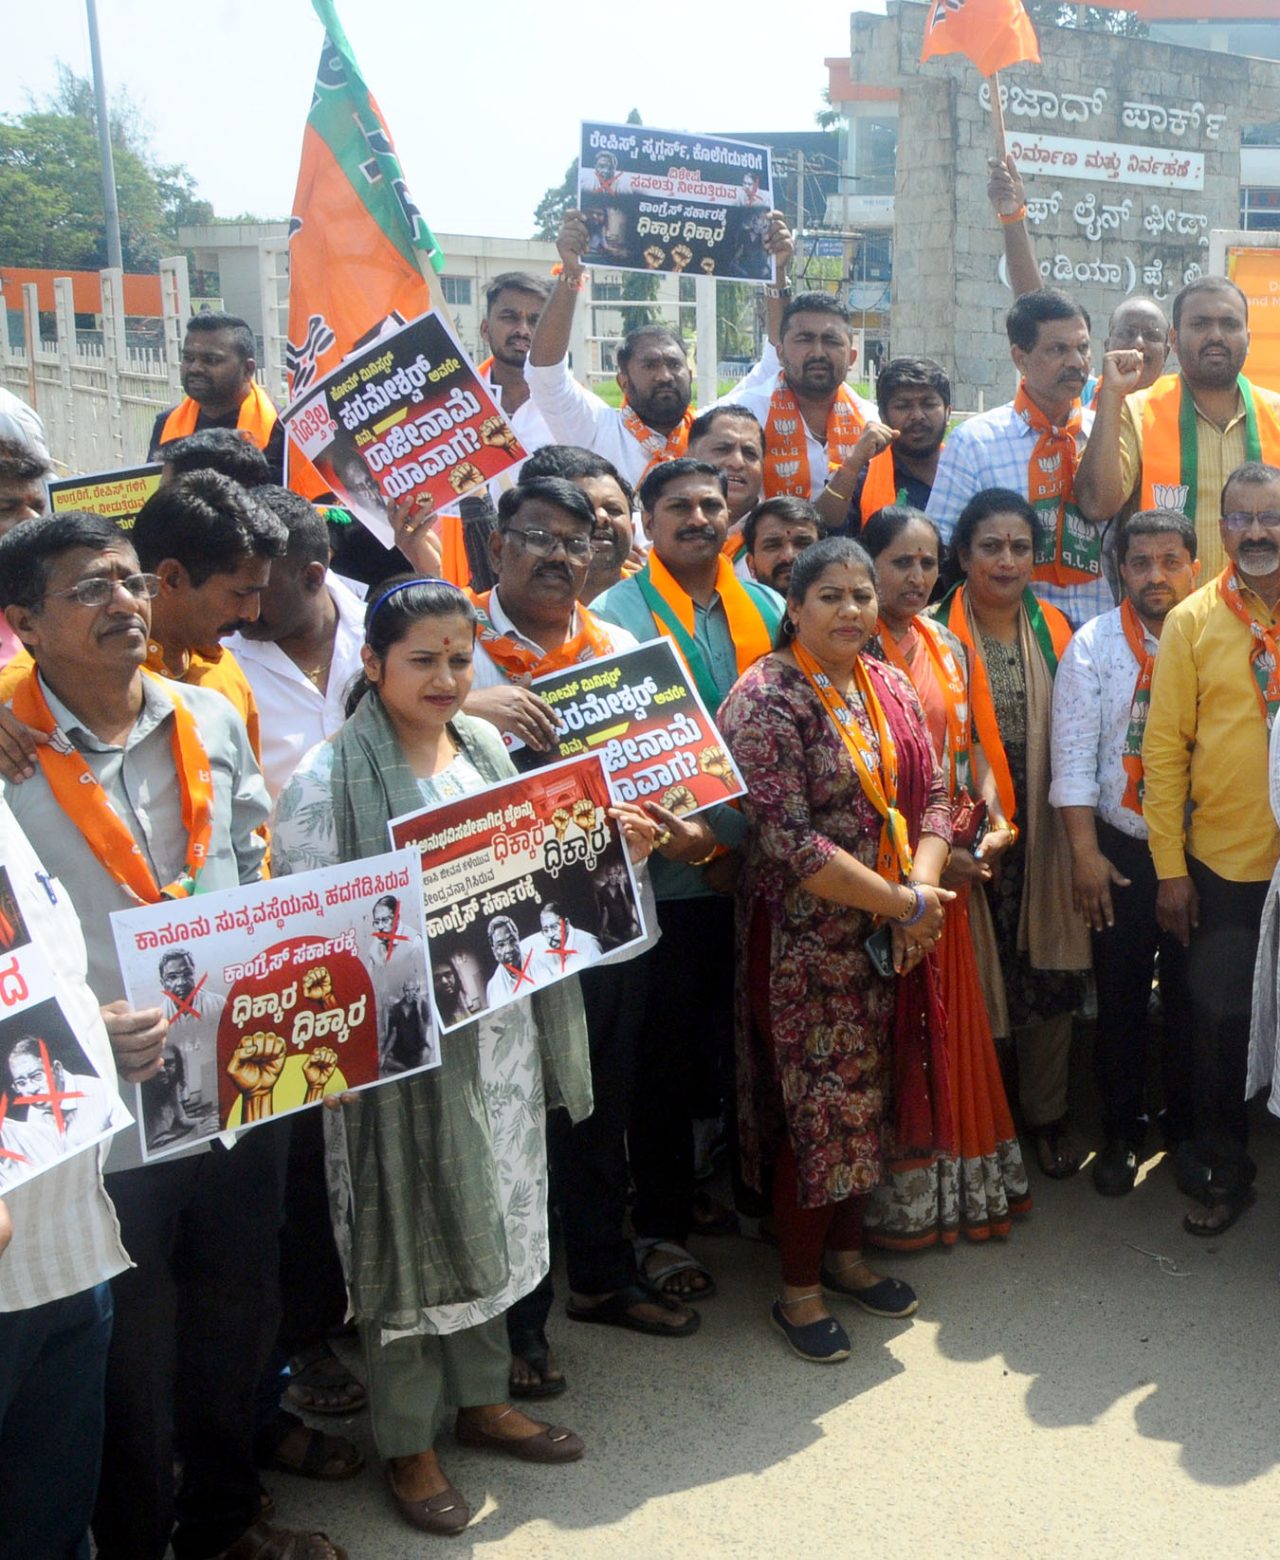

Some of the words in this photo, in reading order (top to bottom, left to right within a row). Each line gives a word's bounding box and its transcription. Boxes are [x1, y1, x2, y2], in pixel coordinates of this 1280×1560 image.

[1122, 102, 1226, 139] ಪಾರ್ಕ್
[1084, 150, 1121, 179] ಮತ್ತು
[638, 200, 683, 218] ಕಾಂಗ್ರೆಸ್
[1026, 191, 1062, 225] ಫ್
[338, 354, 431, 430] ಪರಮೇಶ್ವರ್
[364, 385, 483, 473] ರಾಜೀನಾಮೆ
[382, 426, 483, 499] ಯಾವಾಗ?
[135, 915, 210, 952] ಕಾನೂನು
[326, 867, 410, 907] ಹದಗೆಡಿಸಿರುವ
[223, 947, 290, 984] ಕಾಂಗ್ರೆಸ್
[231, 981, 298, 1029] ಧಿಕ್ಕಾರ
[291, 995, 367, 1049] ಧಿಕ್ಕಾರ
